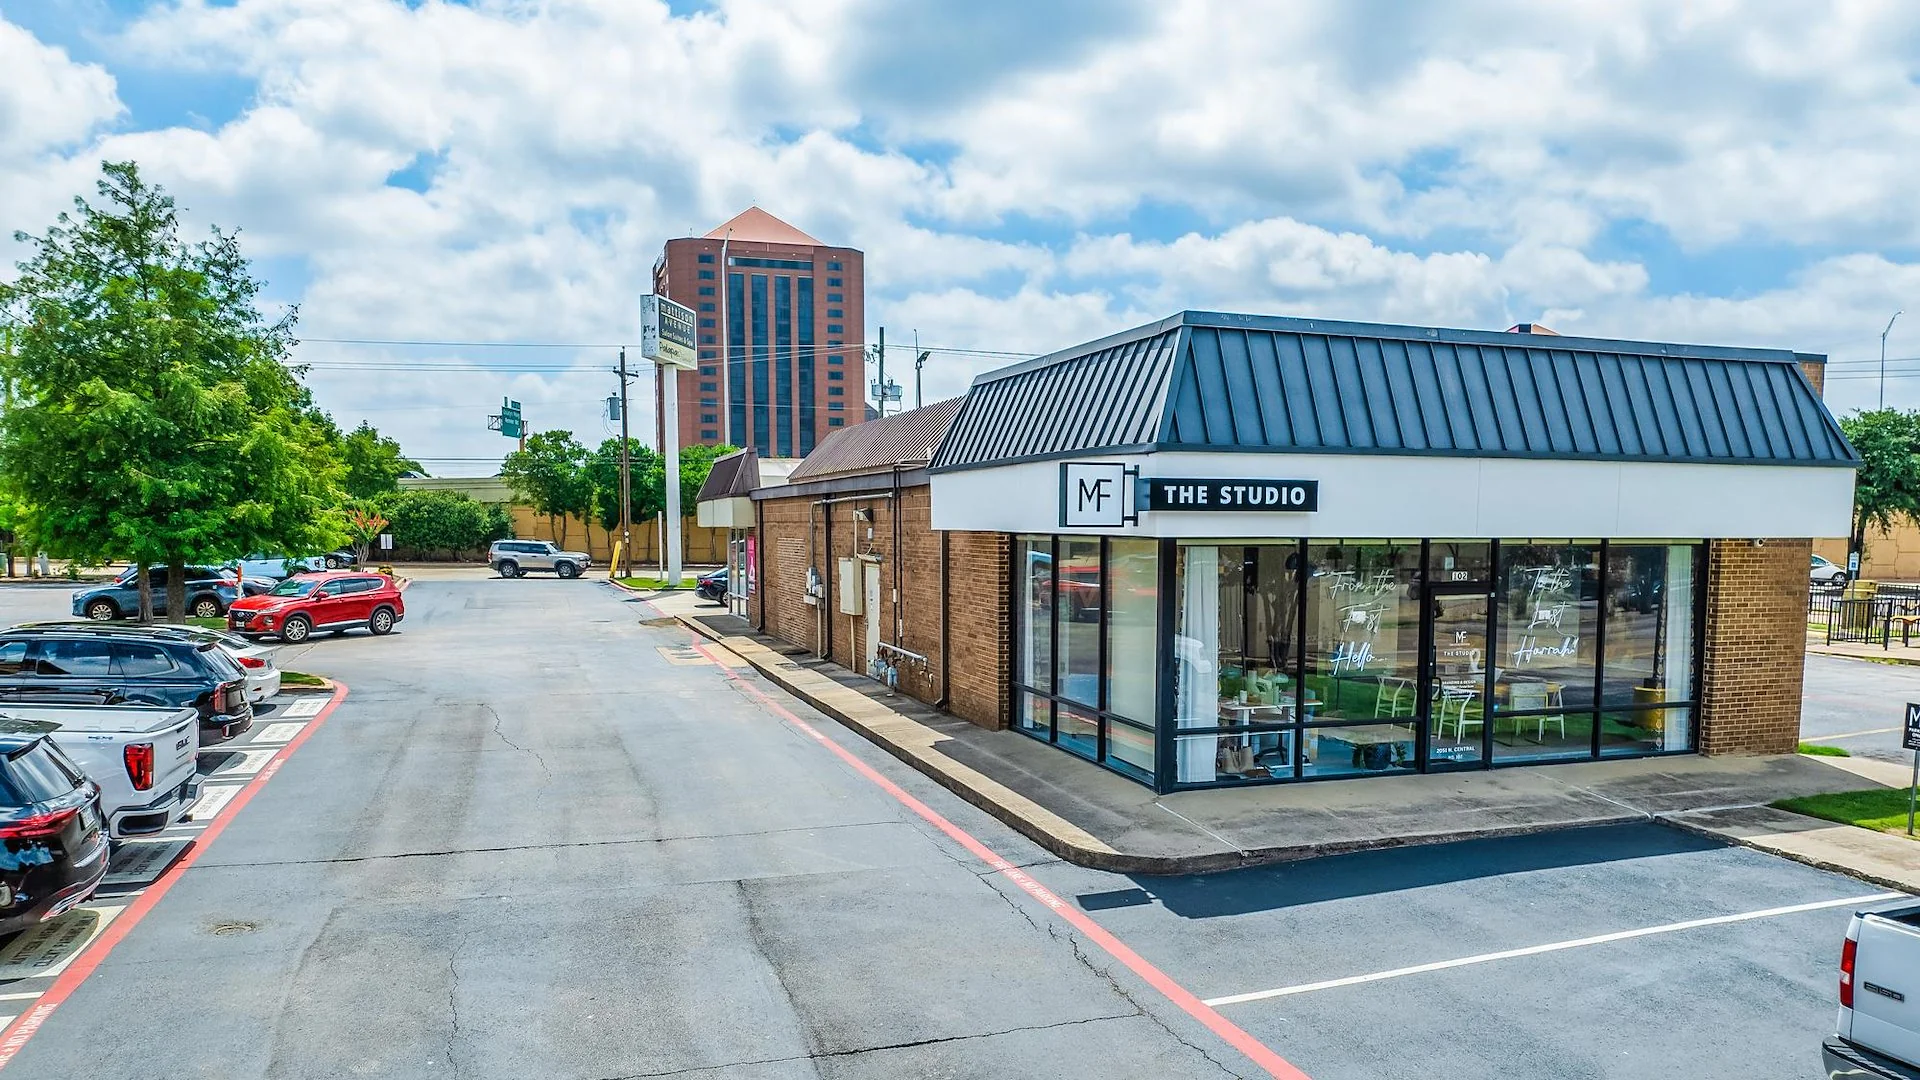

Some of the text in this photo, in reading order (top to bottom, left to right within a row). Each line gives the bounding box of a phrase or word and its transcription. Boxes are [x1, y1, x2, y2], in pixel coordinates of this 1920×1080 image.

[664, 316, 691, 335] AVENUE
[1078, 478, 1112, 512] MF
[1163, 485, 1306, 506] THE STUDIO
[1372, 568, 1397, 597] the
[1453, 572, 1467, 580] 102
[1525, 567, 1572, 597] To the
[1455, 631, 1467, 643] MF
